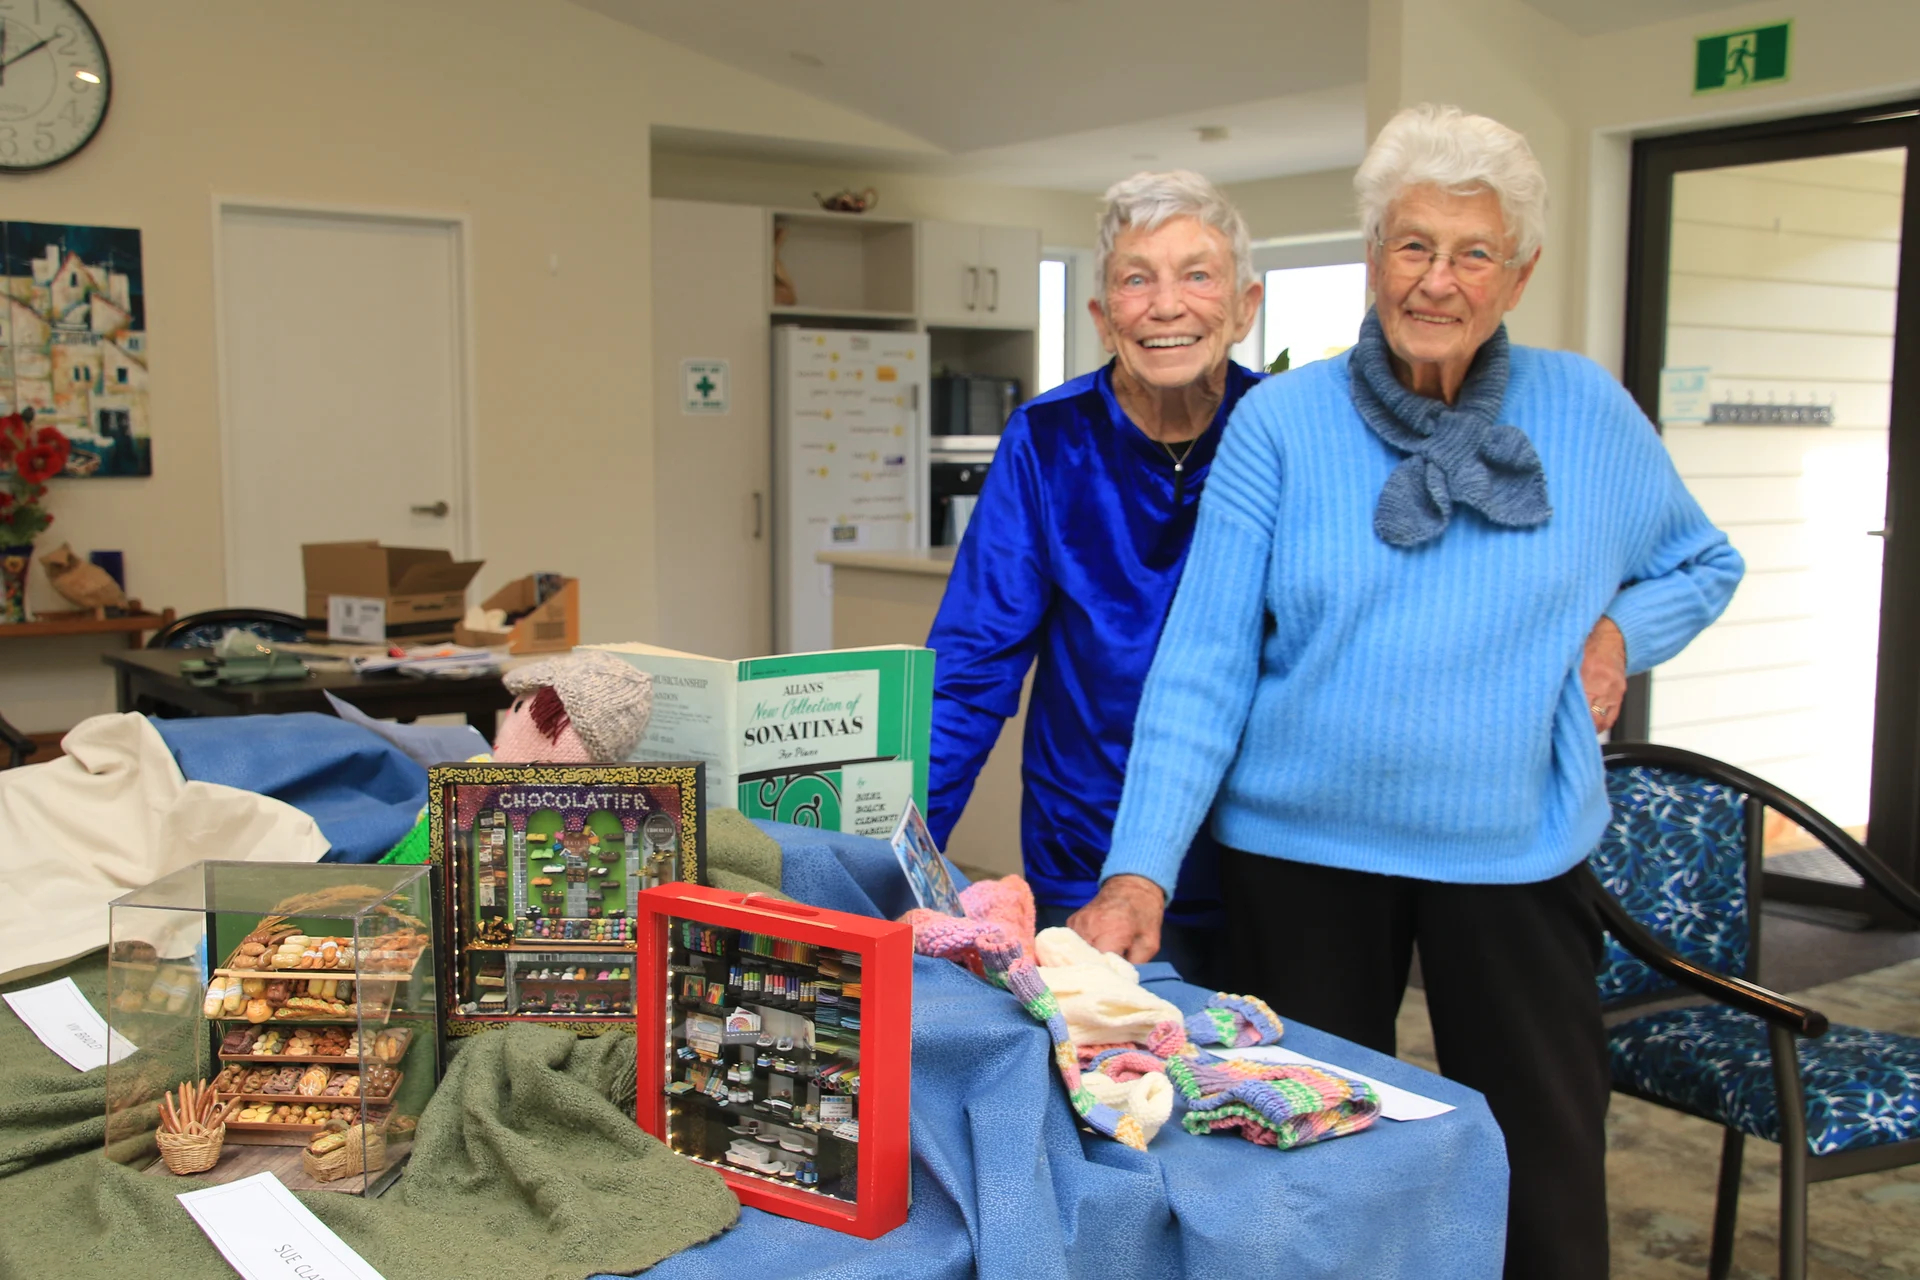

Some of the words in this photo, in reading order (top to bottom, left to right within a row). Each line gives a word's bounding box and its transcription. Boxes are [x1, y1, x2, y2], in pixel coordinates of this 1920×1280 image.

[54, 24, 78, 56] 2
[57, 98, 85, 128] 4
[33, 120, 56, 153] 5
[750, 699, 779, 724] New
[782, 697, 842, 720] Collection
[846, 693, 862, 716] of
[743, 716, 864, 747] SONATINAS
[777, 749, 793, 760] For
[794, 745, 819, 759] Piano
[498, 791, 650, 811] CHOCOLATIER
[274, 1243, 303, 1265] SUE
[294, 1264, 325, 1280] CLA
